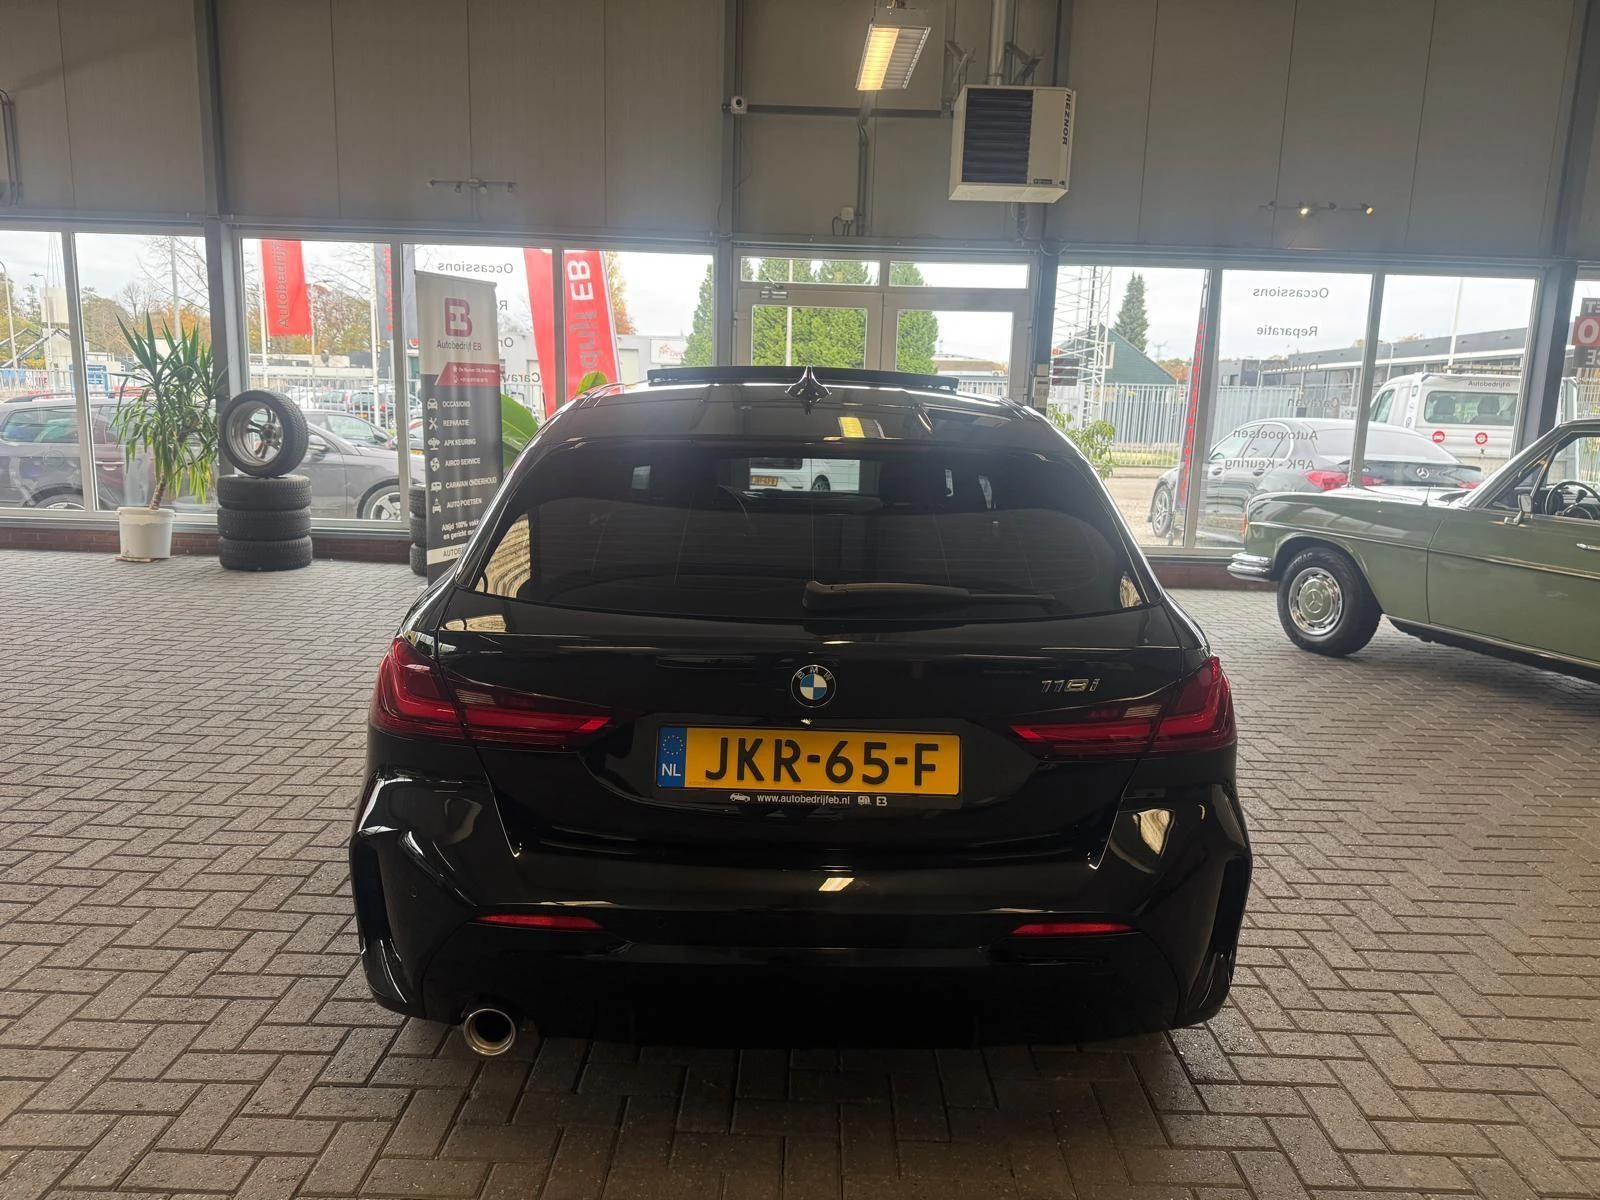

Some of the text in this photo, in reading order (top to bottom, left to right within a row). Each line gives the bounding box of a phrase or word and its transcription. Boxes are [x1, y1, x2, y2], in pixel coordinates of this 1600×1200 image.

[1062, 93, 1071, 145] REZNOR
[437, 340, 482, 352] Autobedrijf EB
[442, 400, 471, 408] OCCASIONS
[445, 457, 481, 467] AIRCO SERVICE
[445, 480, 469, 489] CARAVAN
[796, 666, 832, 681] BMW
[1041, 678, 1101, 693] 118i
[704, 736, 940, 786] JKR-65-F
[661, 763, 682, 778] NL
[756, 794, 850, 806] www.autobedrijfeb.nl
